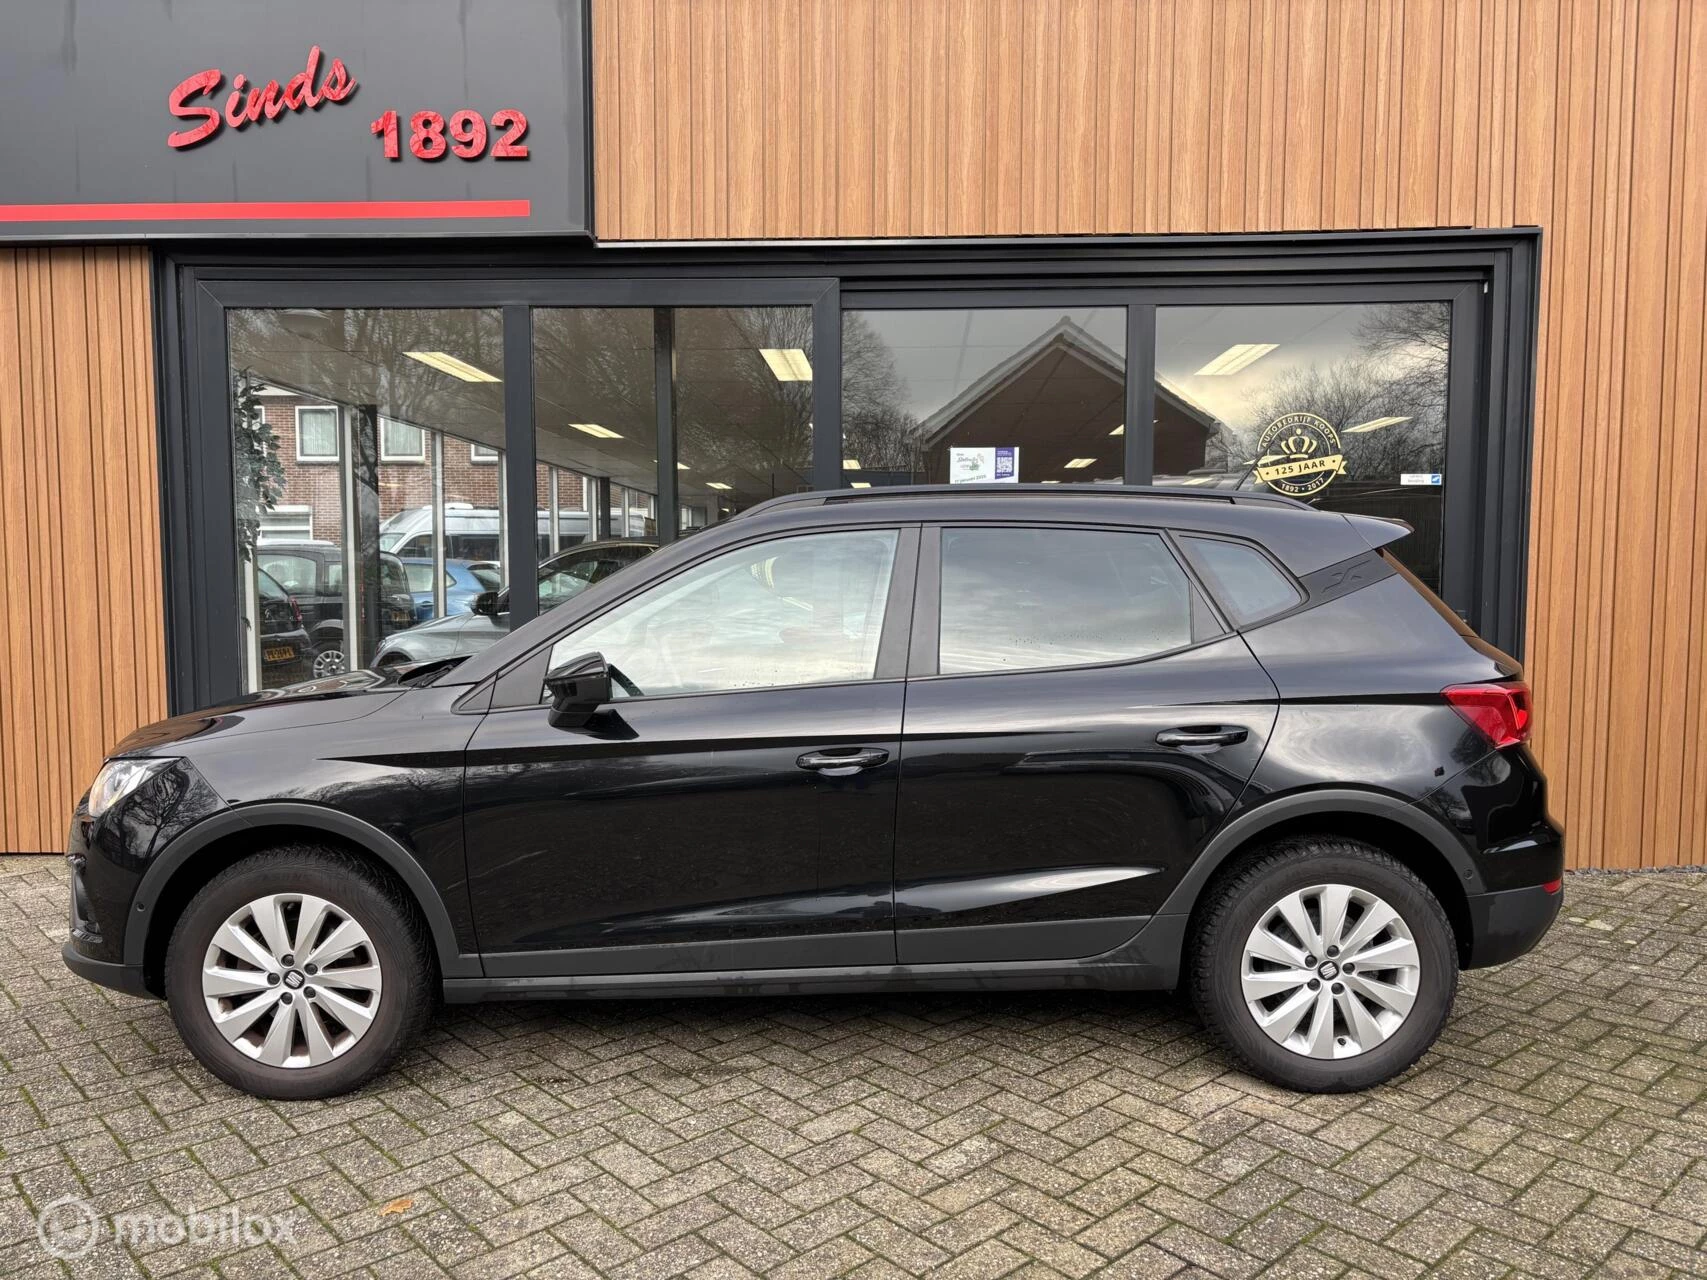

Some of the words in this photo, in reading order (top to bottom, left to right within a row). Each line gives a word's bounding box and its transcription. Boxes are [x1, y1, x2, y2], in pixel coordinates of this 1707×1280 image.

[167, 45, 357, 148] Sinds
[370, 109, 529, 160] 1892
[1262, 415, 1312, 448] AUTOBEDRIJF
[1313, 419, 1336, 445] KOOPS
[1274, 465, 1294, 476] 125
[1298, 459, 1326, 473] JAAR
[1281, 483, 1299, 493] 1892
[1307, 477, 1324, 490] 2017
